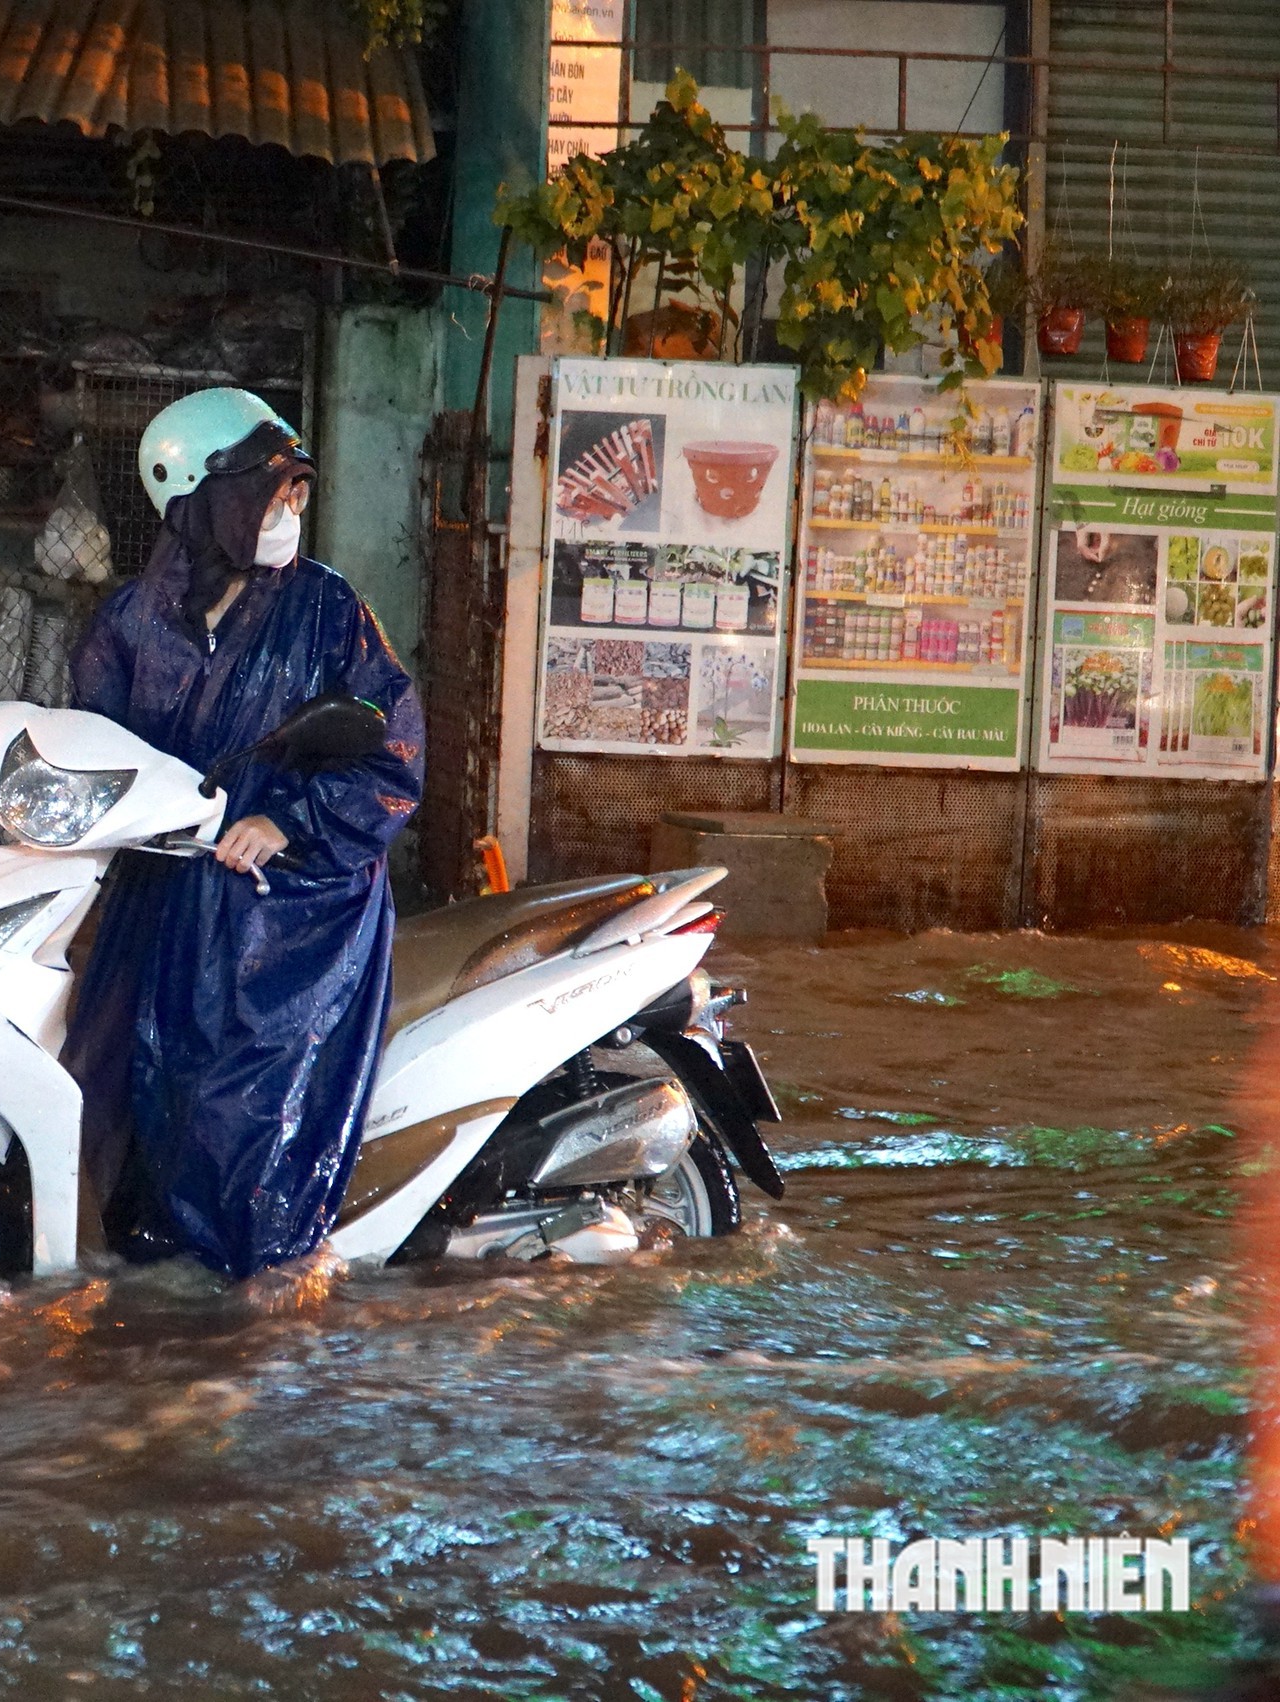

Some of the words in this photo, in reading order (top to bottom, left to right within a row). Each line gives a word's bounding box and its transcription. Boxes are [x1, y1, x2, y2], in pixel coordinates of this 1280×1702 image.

[564, 369, 607, 399] VẬT
[613, 375, 648, 397] TƯ
[645, 370, 734, 401] TRỒNG
[743, 383, 791, 404] LAN
[1122, 497, 1155, 519] Hạt
[853, 693, 900, 712] PHÂN
[802, 722, 827, 734] HOA
[828, 723, 852, 735] LAN
[862, 722, 884, 736] CÂY
[932, 725, 954, 739] CÂY
[956, 728, 981, 740] RAU
